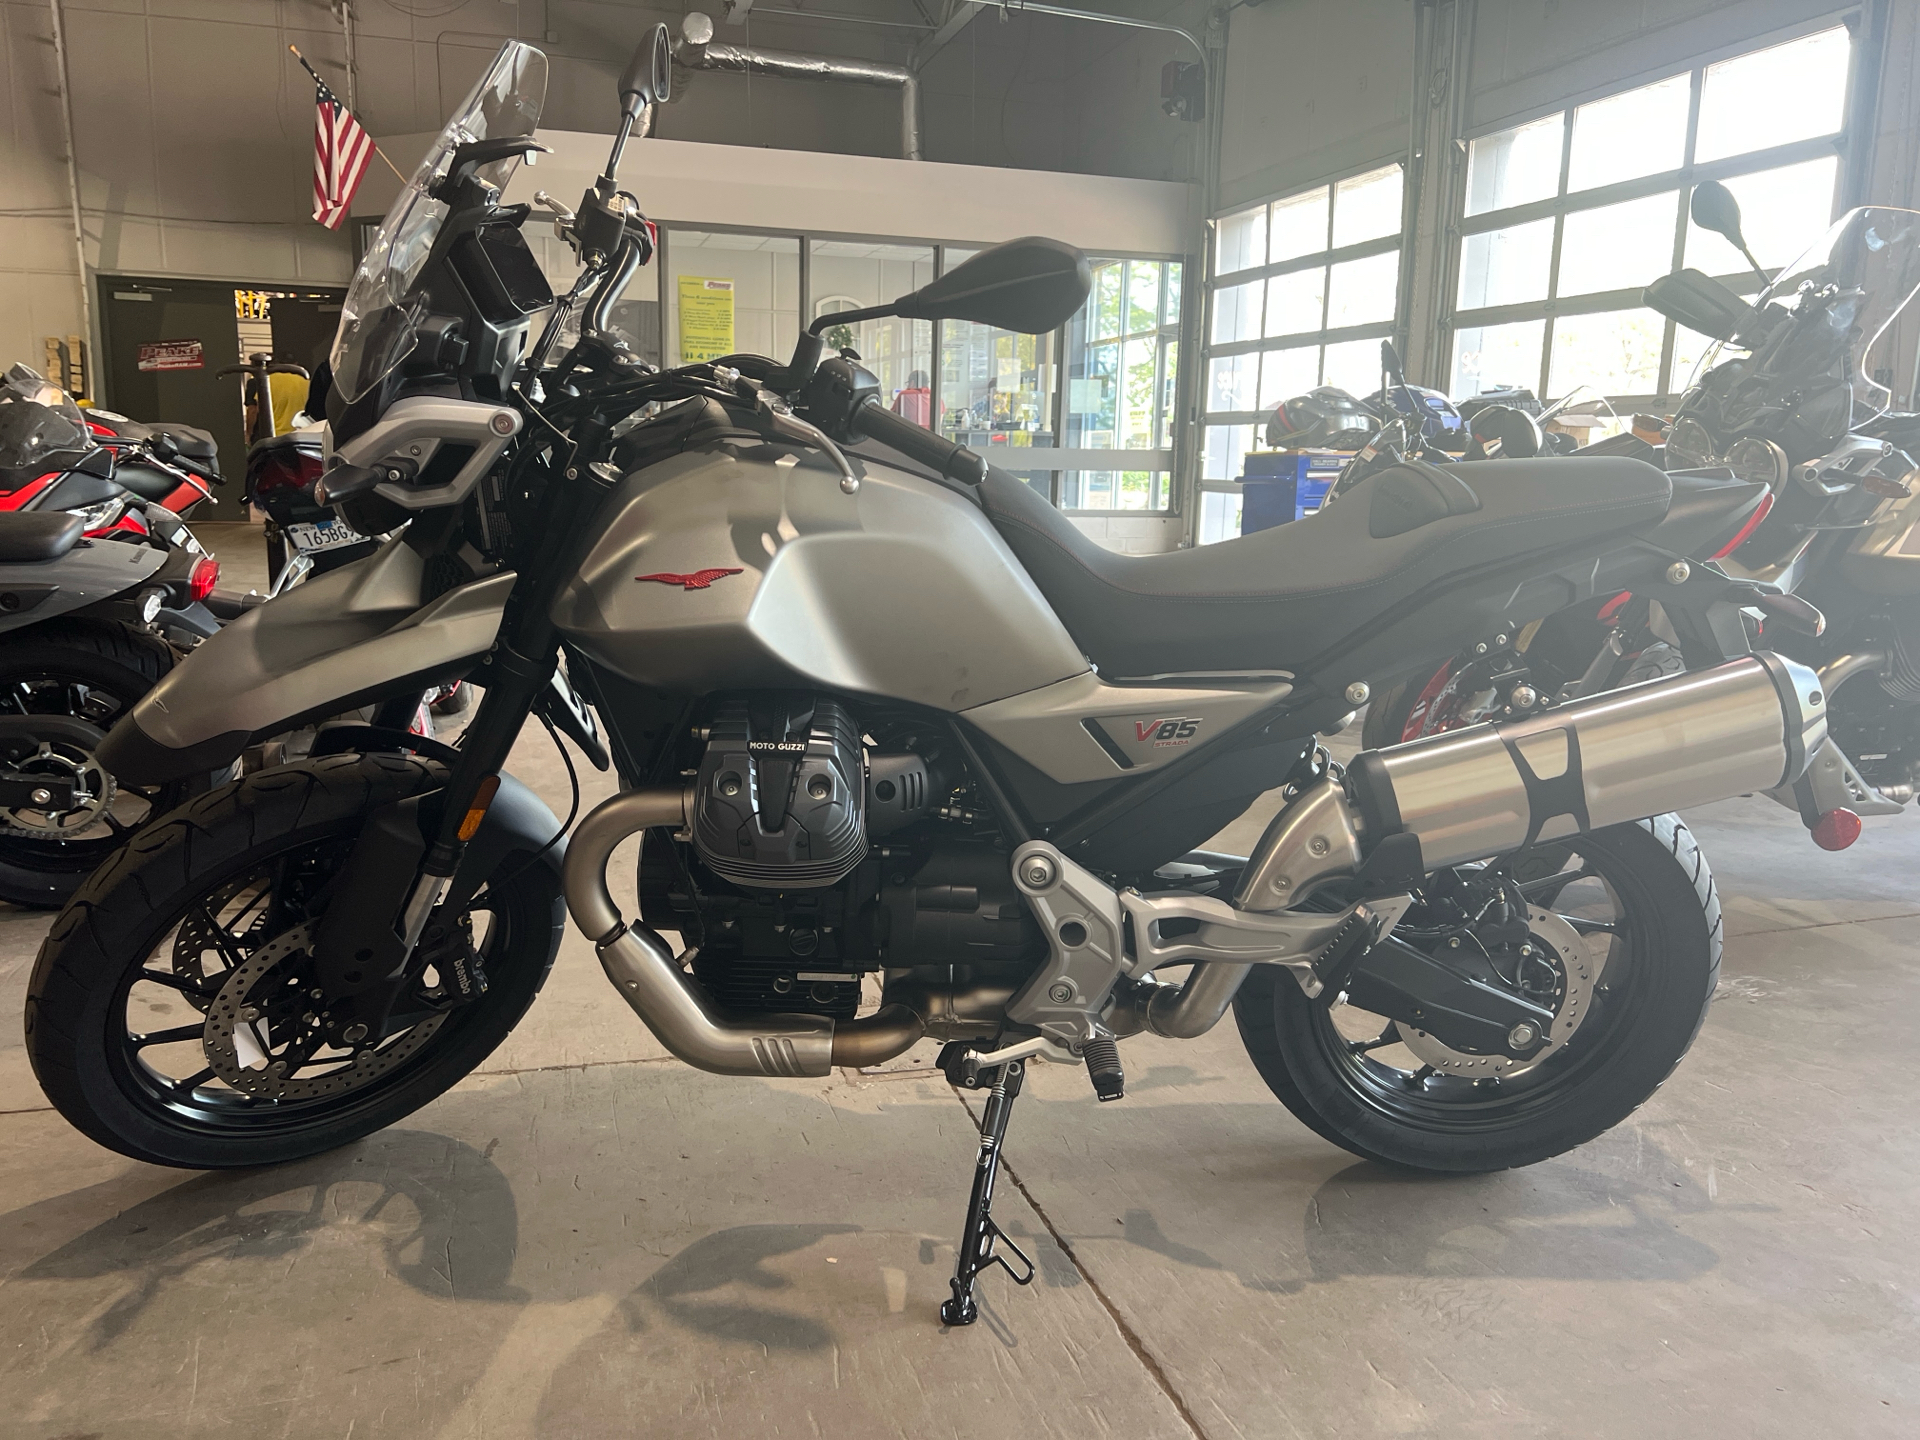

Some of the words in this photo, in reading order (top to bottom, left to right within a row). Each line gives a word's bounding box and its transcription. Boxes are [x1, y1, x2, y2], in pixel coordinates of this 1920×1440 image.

[140, 346, 199, 359] PEAKE
[1135, 717, 1203, 742] V85
[749, 742, 775, 750] MOTO
[777, 743, 805, 751] GUZZI
[1153, 740, 1189, 748] STRADA
[453, 957, 472, 994] brembo
